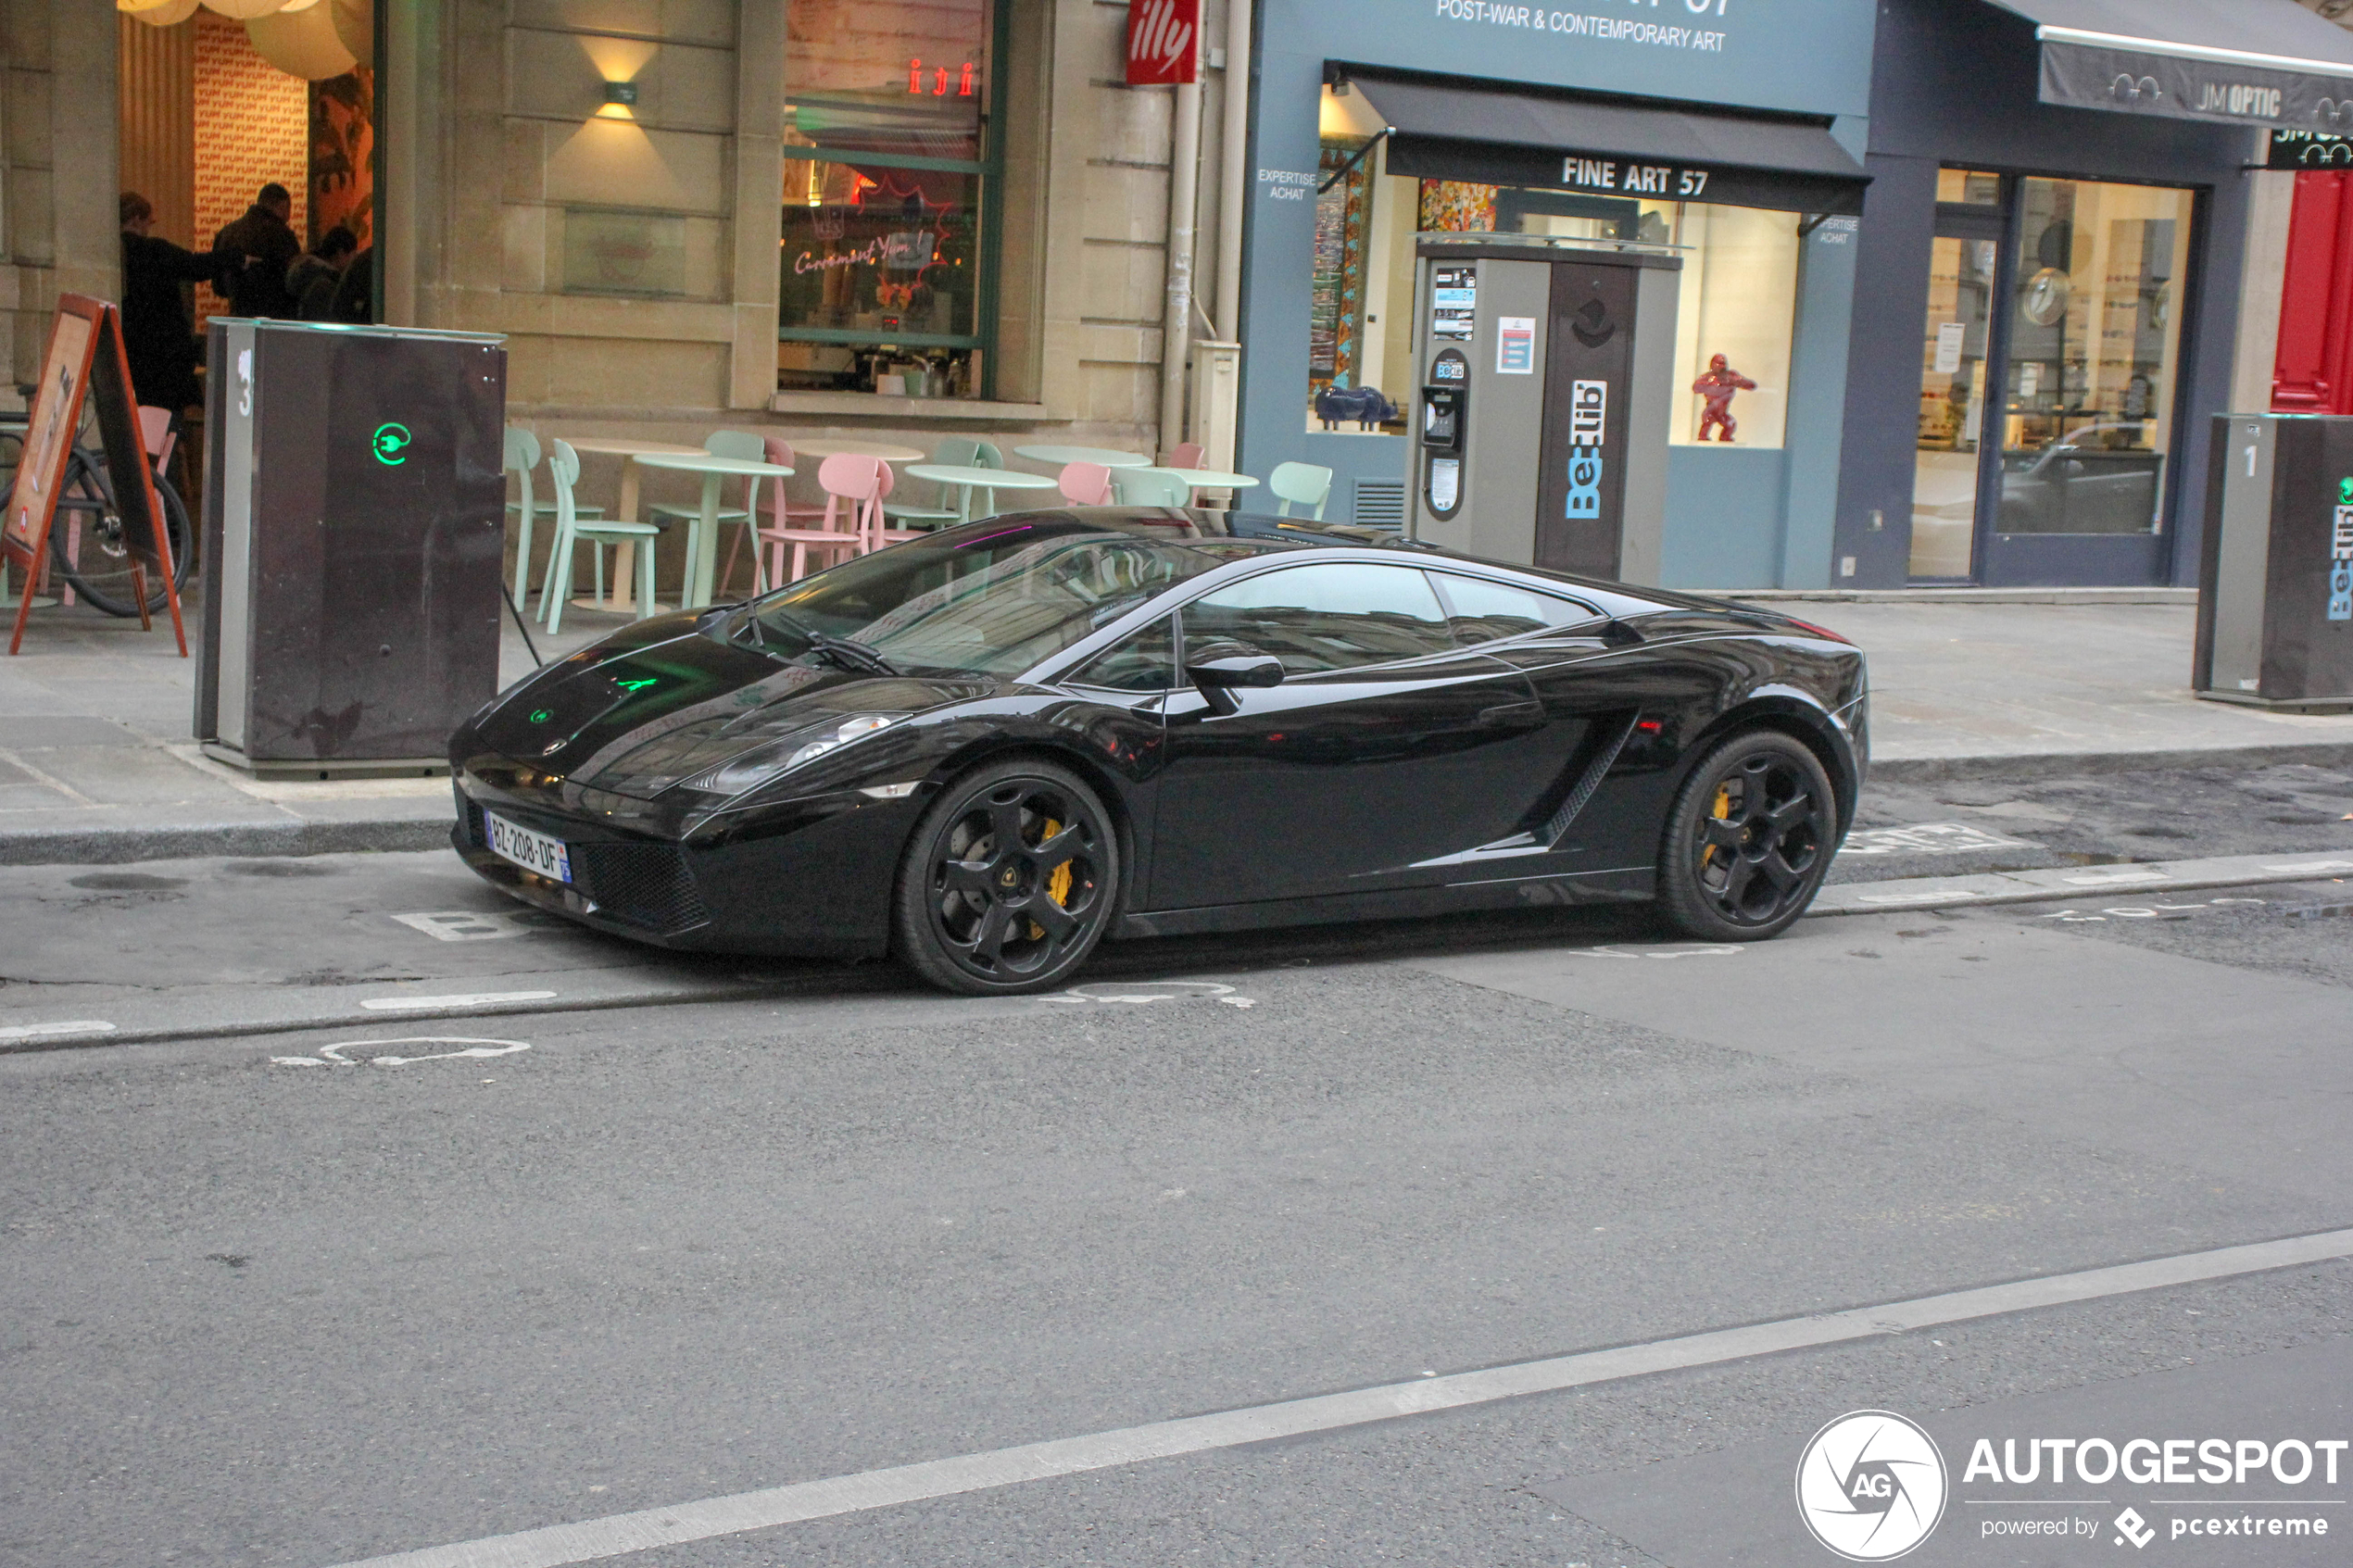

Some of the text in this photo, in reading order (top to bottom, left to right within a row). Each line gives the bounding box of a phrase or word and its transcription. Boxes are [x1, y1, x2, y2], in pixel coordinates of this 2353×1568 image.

[1438, 0, 1726, 52] POST-WAR & CONTEMPORARY ART
[1131, 0, 1192, 75] illy
[199, 67, 220, 76] YUM
[223, 69, 245, 79] YUM
[246, 71, 268, 81] YUM
[270, 73, 291, 83] YUM
[212, 78, 233, 88] YUM
[236, 81, 257, 91] YUM
[260, 83, 280, 93] YUM
[283, 85, 303, 95] YUM
[199, 88, 220, 97] YUM
[223, 90, 245, 100] YUM
[246, 93, 268, 102] YUM
[270, 94, 291, 104] YUM
[2196, 82, 2282, 118] JM OPTIC
[212, 100, 233, 109] YUM
[236, 102, 257, 112] YUM
[260, 105, 280, 114] YUM
[283, 107, 303, 116] YUM
[199, 109, 220, 119] YUM
[223, 111, 245, 121] YUM
[246, 113, 268, 123] YUM
[270, 116, 291, 125] YUM
[212, 121, 233, 131] YUM
[236, 123, 257, 133] YUM
[260, 125, 280, 135] YUM
[283, 128, 303, 137] YUM
[199, 131, 220, 140] YUM
[223, 132, 245, 143] YUM
[246, 134, 268, 144] YUM
[270, 137, 291, 146] YUM
[212, 143, 233, 152] YUM
[236, 144, 257, 155] YUM
[260, 146, 280, 157] YUM
[283, 149, 303, 158] YUM
[199, 152, 220, 161] YUM
[223, 154, 245, 164] YUM
[246, 156, 268, 166] YUM
[270, 158, 291, 168] YUM
[199, 173, 220, 183] YUM
[223, 175, 245, 185] YUM
[246, 177, 268, 187] YUM
[212, 164, 233, 173] YUM
[236, 166, 257, 176] YUM
[260, 168, 280, 178] YUM
[283, 170, 303, 180] YUM
[1259, 169, 1316, 185] EXPERTISE
[1563, 157, 1708, 196] FINE ART 57
[212, 185, 233, 194] YUM
[236, 187, 257, 197] YUM
[1270, 186, 1305, 200] ACHAT
[199, 194, 220, 205] YUM
[223, 196, 245, 207] YUM
[212, 207, 233, 217] YUM
[199, 216, 220, 226] YUM
[1820, 232, 1848, 244] ACHAT
[2245, 445, 2258, 477] 1
